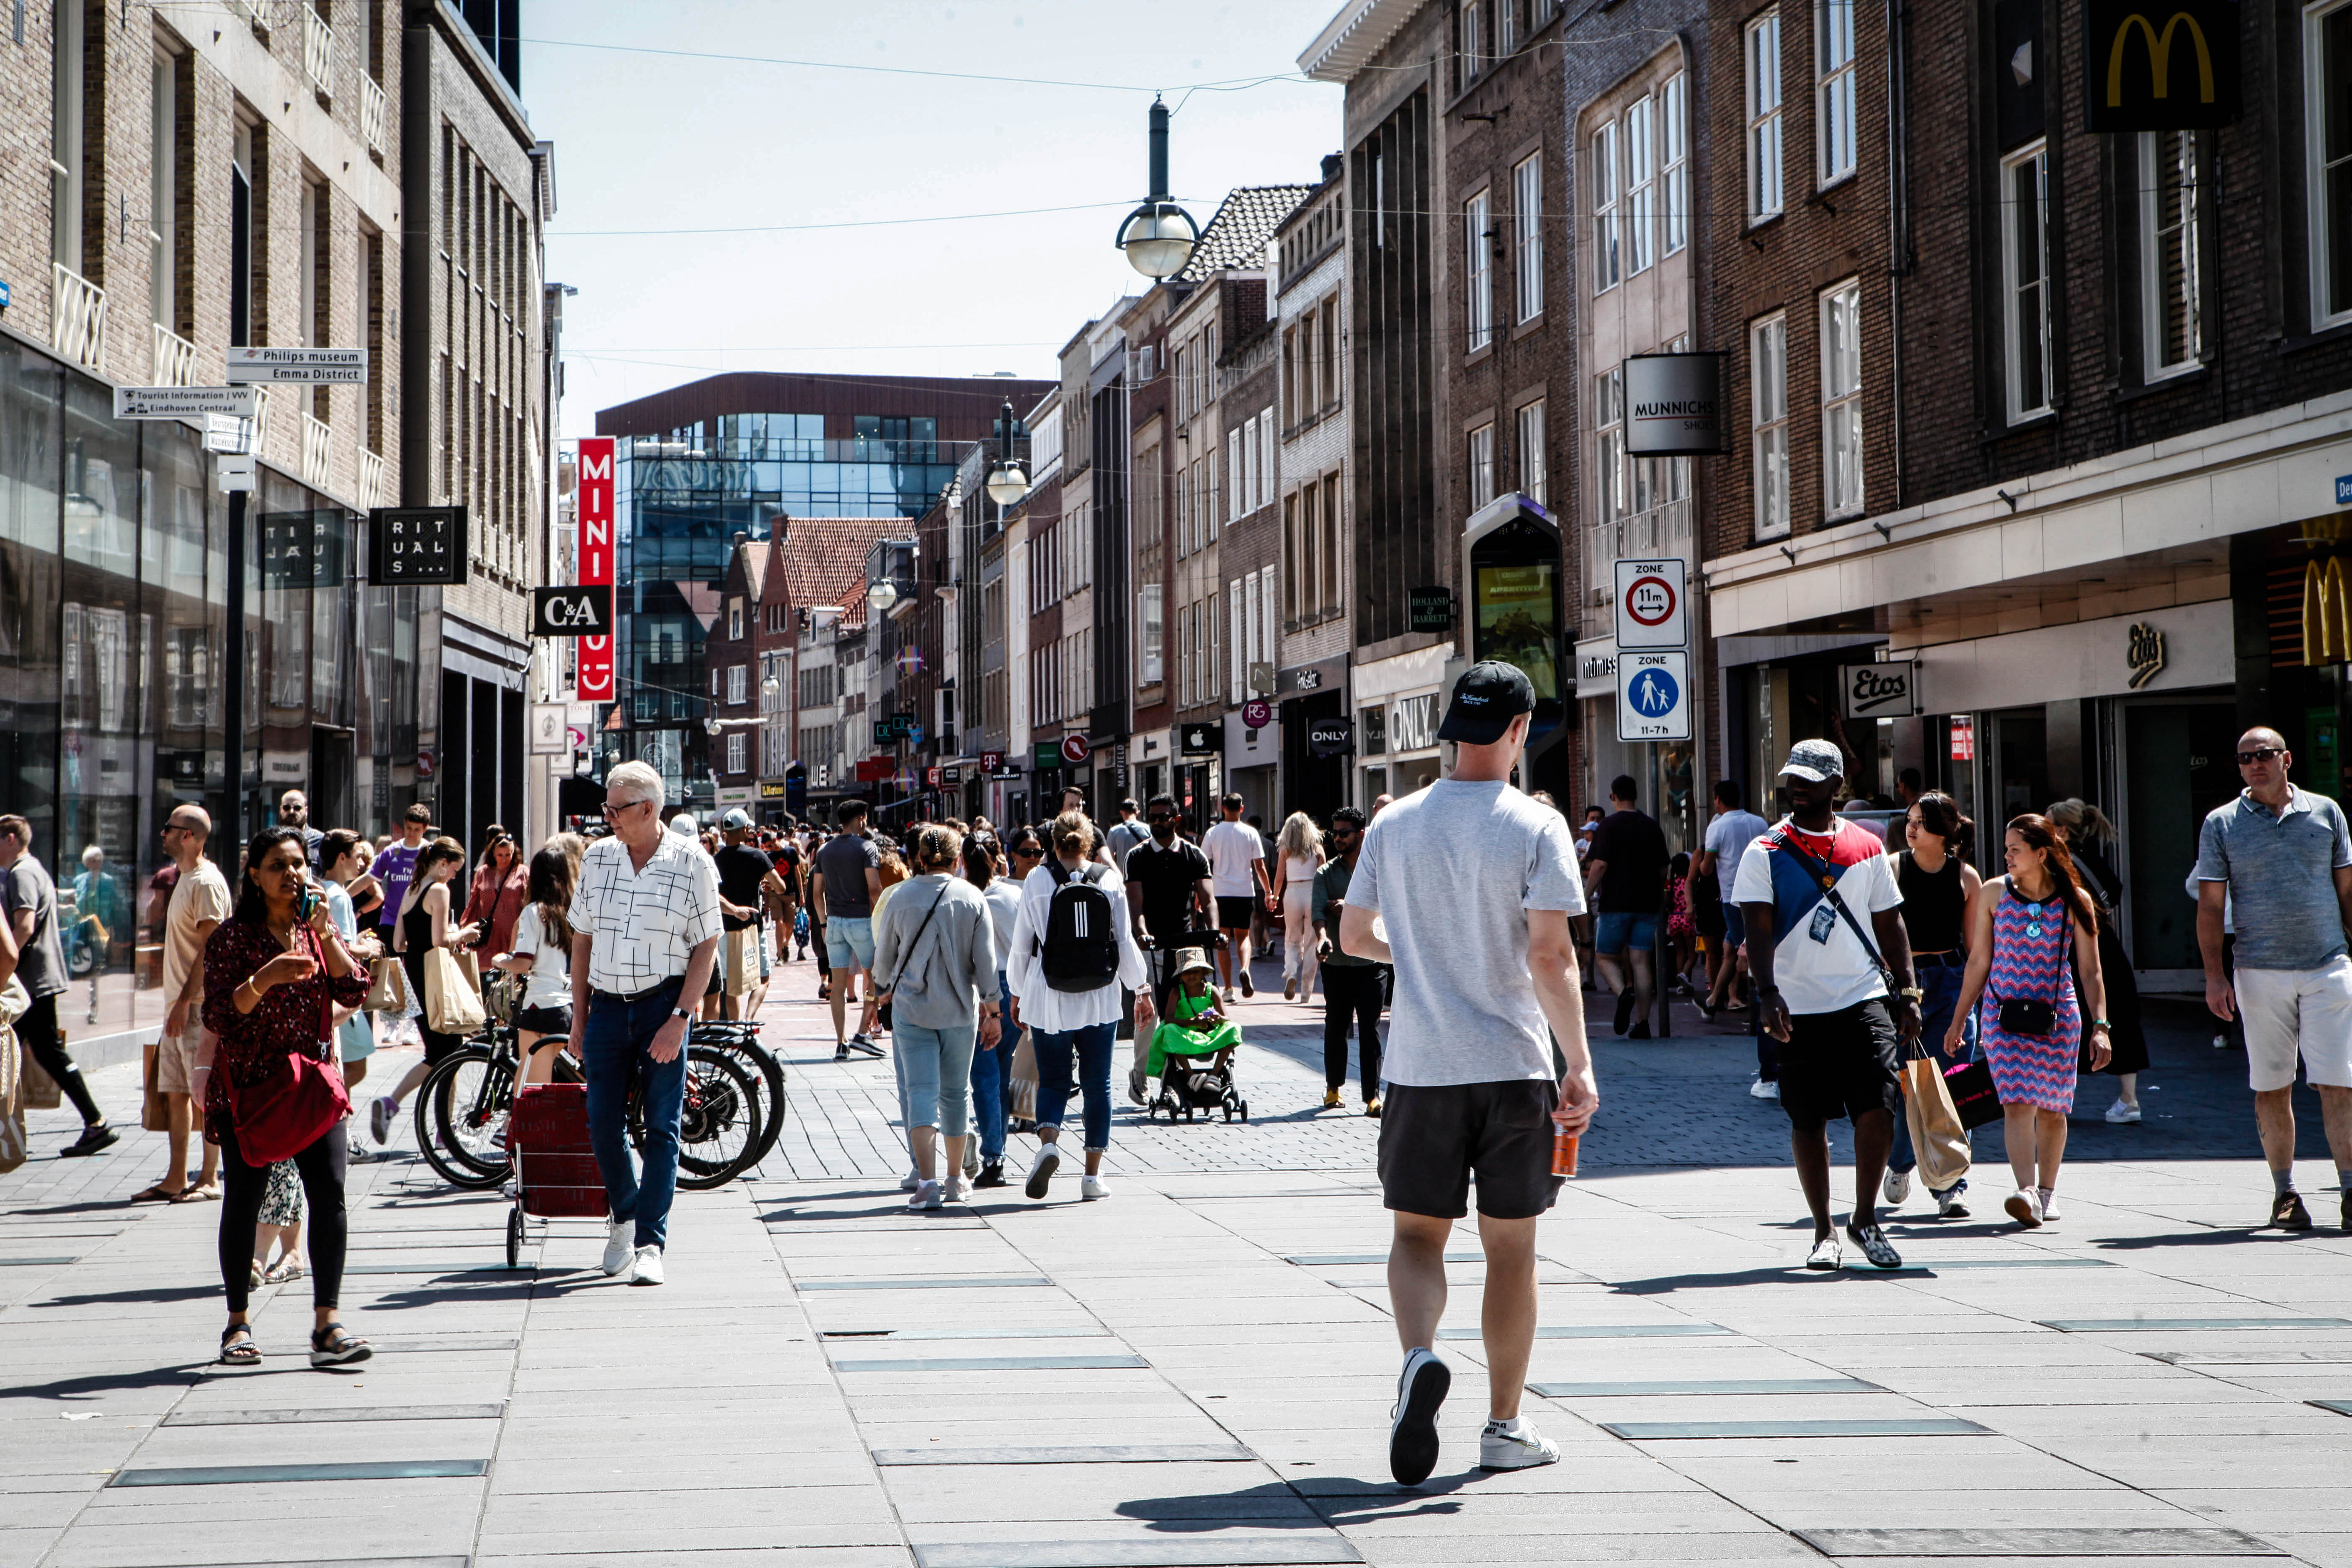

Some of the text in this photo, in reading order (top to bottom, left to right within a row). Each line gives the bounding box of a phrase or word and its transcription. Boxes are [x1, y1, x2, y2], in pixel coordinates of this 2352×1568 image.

[264, 351, 358, 364] Philips museum
[273, 369, 358, 379] Emma District
[1635, 400, 1714, 416] MUNNICHS
[1684, 421, 1714, 430] SHOES
[1636, 565, 1664, 573] ZONE
[1413, 597, 1449, 606] HOLLAND
[544, 596, 599, 626] C&A
[1413, 614, 1448, 623] BARRETT
[1638, 656, 1666, 665] ZONE
[1853, 670, 1906, 700] Etos
[1248, 704, 1265, 718] PG
[1312, 731, 1349, 741] ONLY
[812, 765, 827, 786] WE
